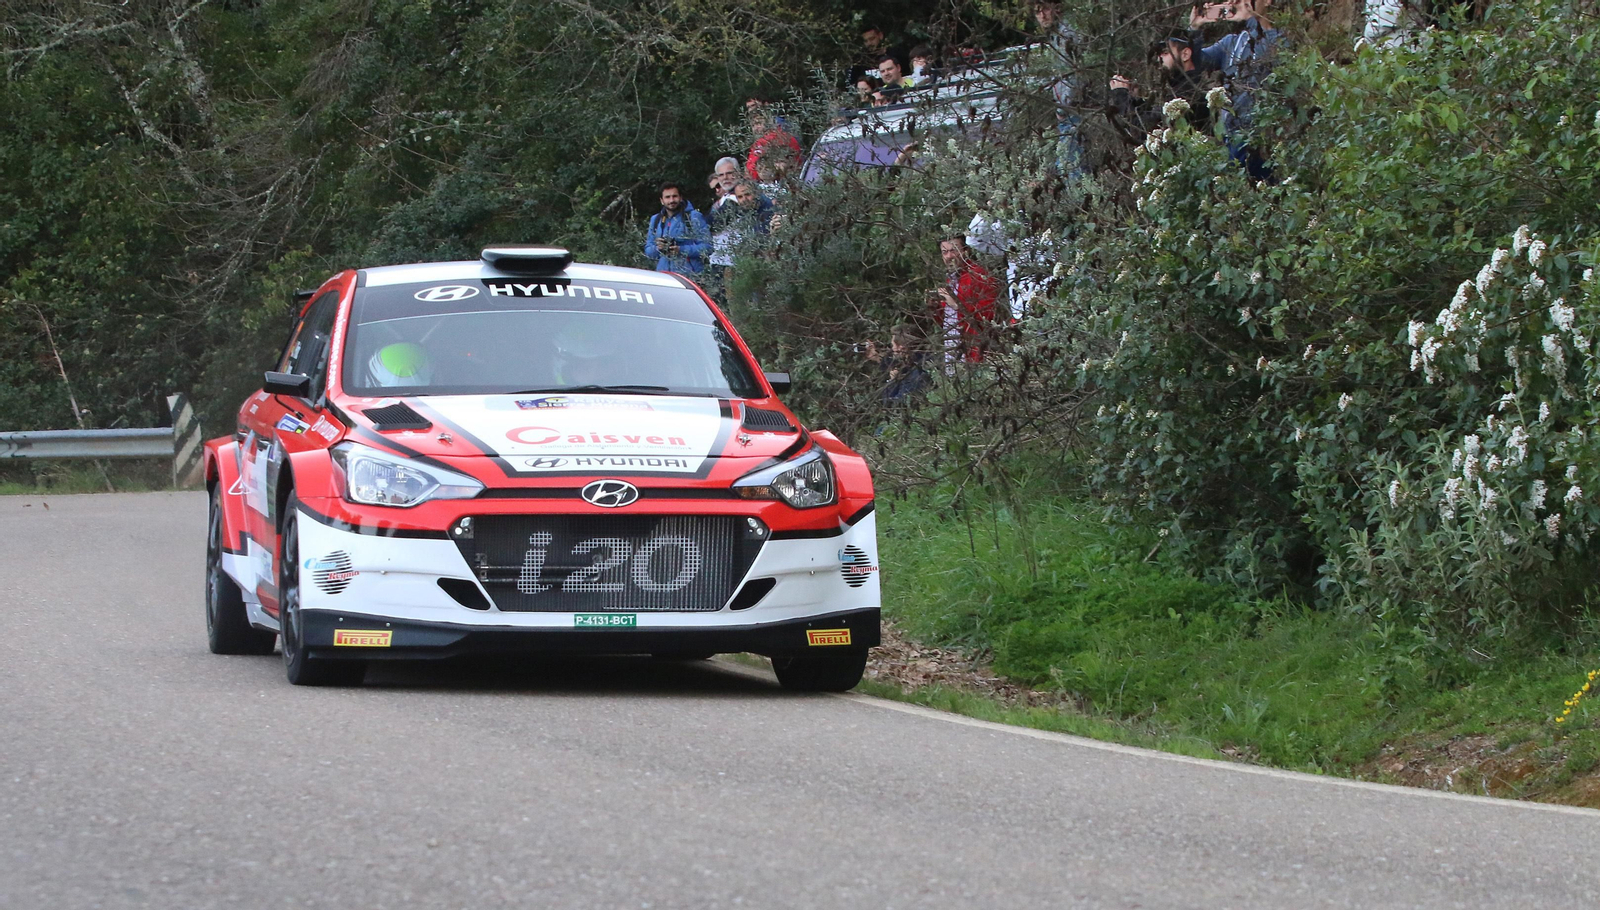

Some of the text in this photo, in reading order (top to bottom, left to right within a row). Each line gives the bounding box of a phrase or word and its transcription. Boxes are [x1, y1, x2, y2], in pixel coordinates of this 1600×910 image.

[488, 283, 655, 305] HYUNDAI
[575, 457, 688, 468] HYUNDAI
[517, 531, 701, 594] i20
[576, 615, 635, 625] P-4131-BCT
[336, 631, 389, 645] PIRELLI
[808, 630, 849, 644] PIRELLI
